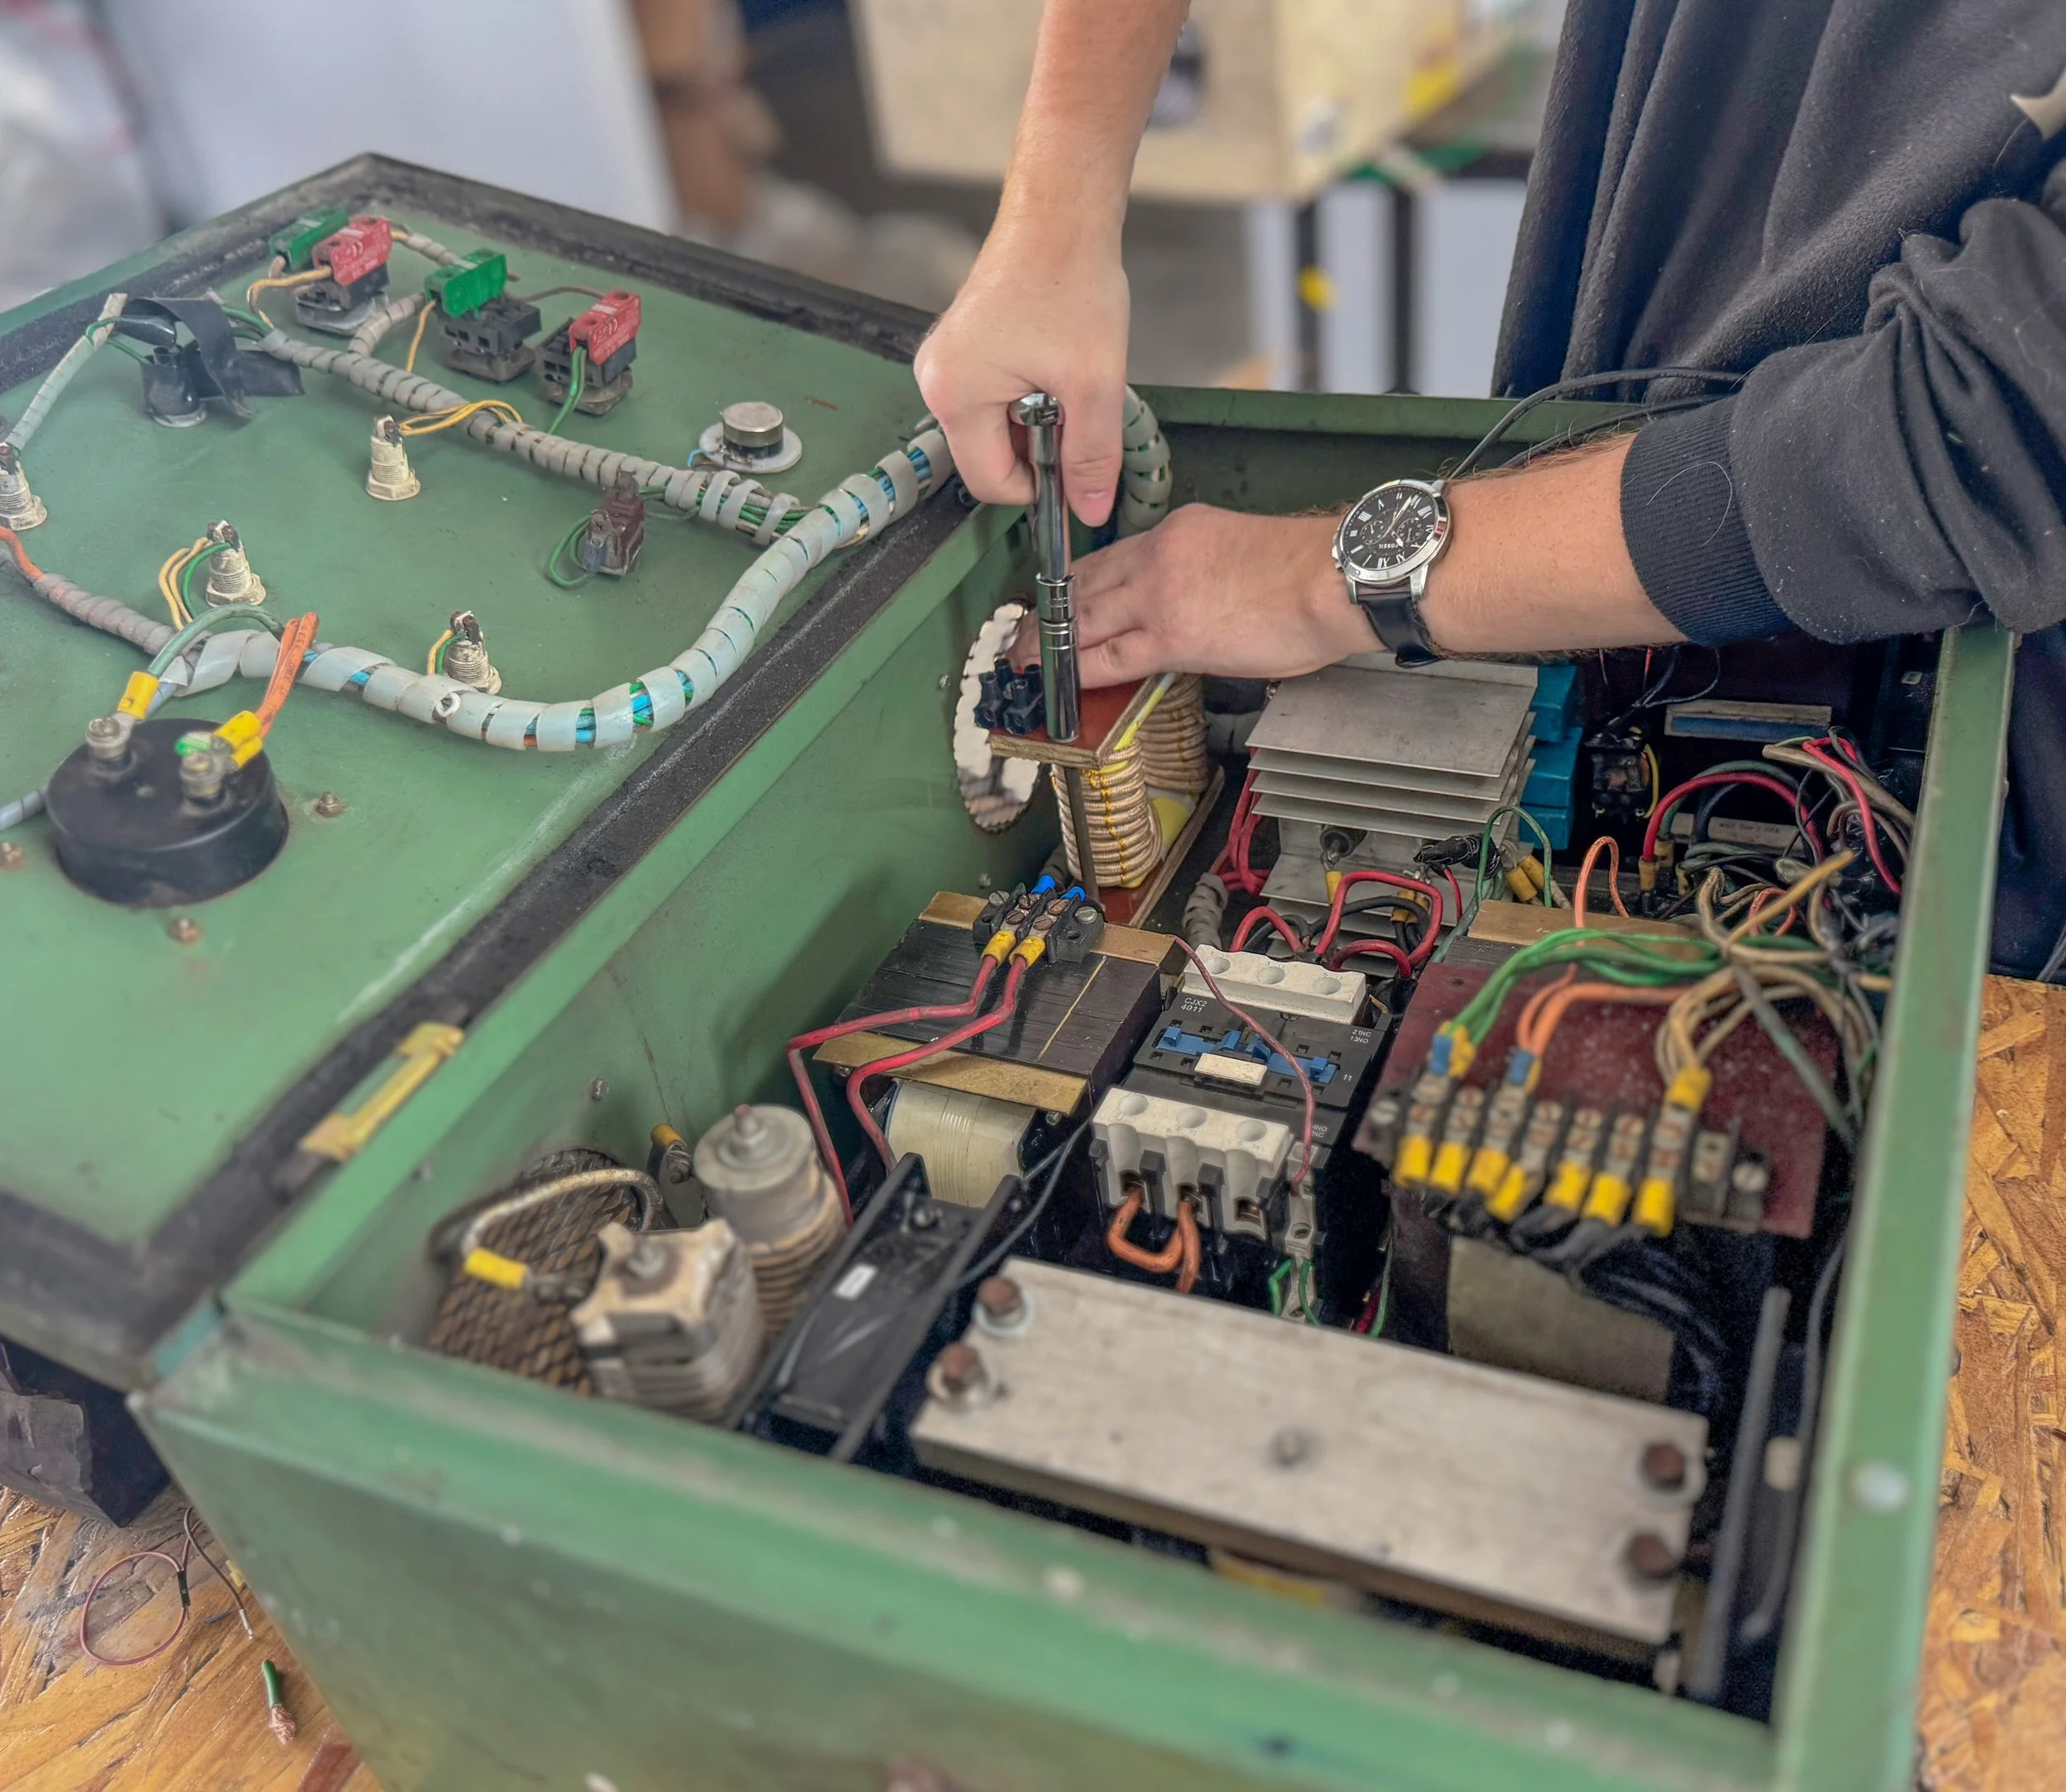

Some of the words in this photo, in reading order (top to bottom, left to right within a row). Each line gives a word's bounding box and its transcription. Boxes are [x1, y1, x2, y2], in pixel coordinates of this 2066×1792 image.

[1184, 997, 1207, 1007] CJX2
[1181, 1004, 1202, 1013] 4011
[1352, 1029, 1372, 1038] 21NC
[1350, 1035, 1369, 1044] 13NO
[1343, 1073, 1353, 1081] 11
